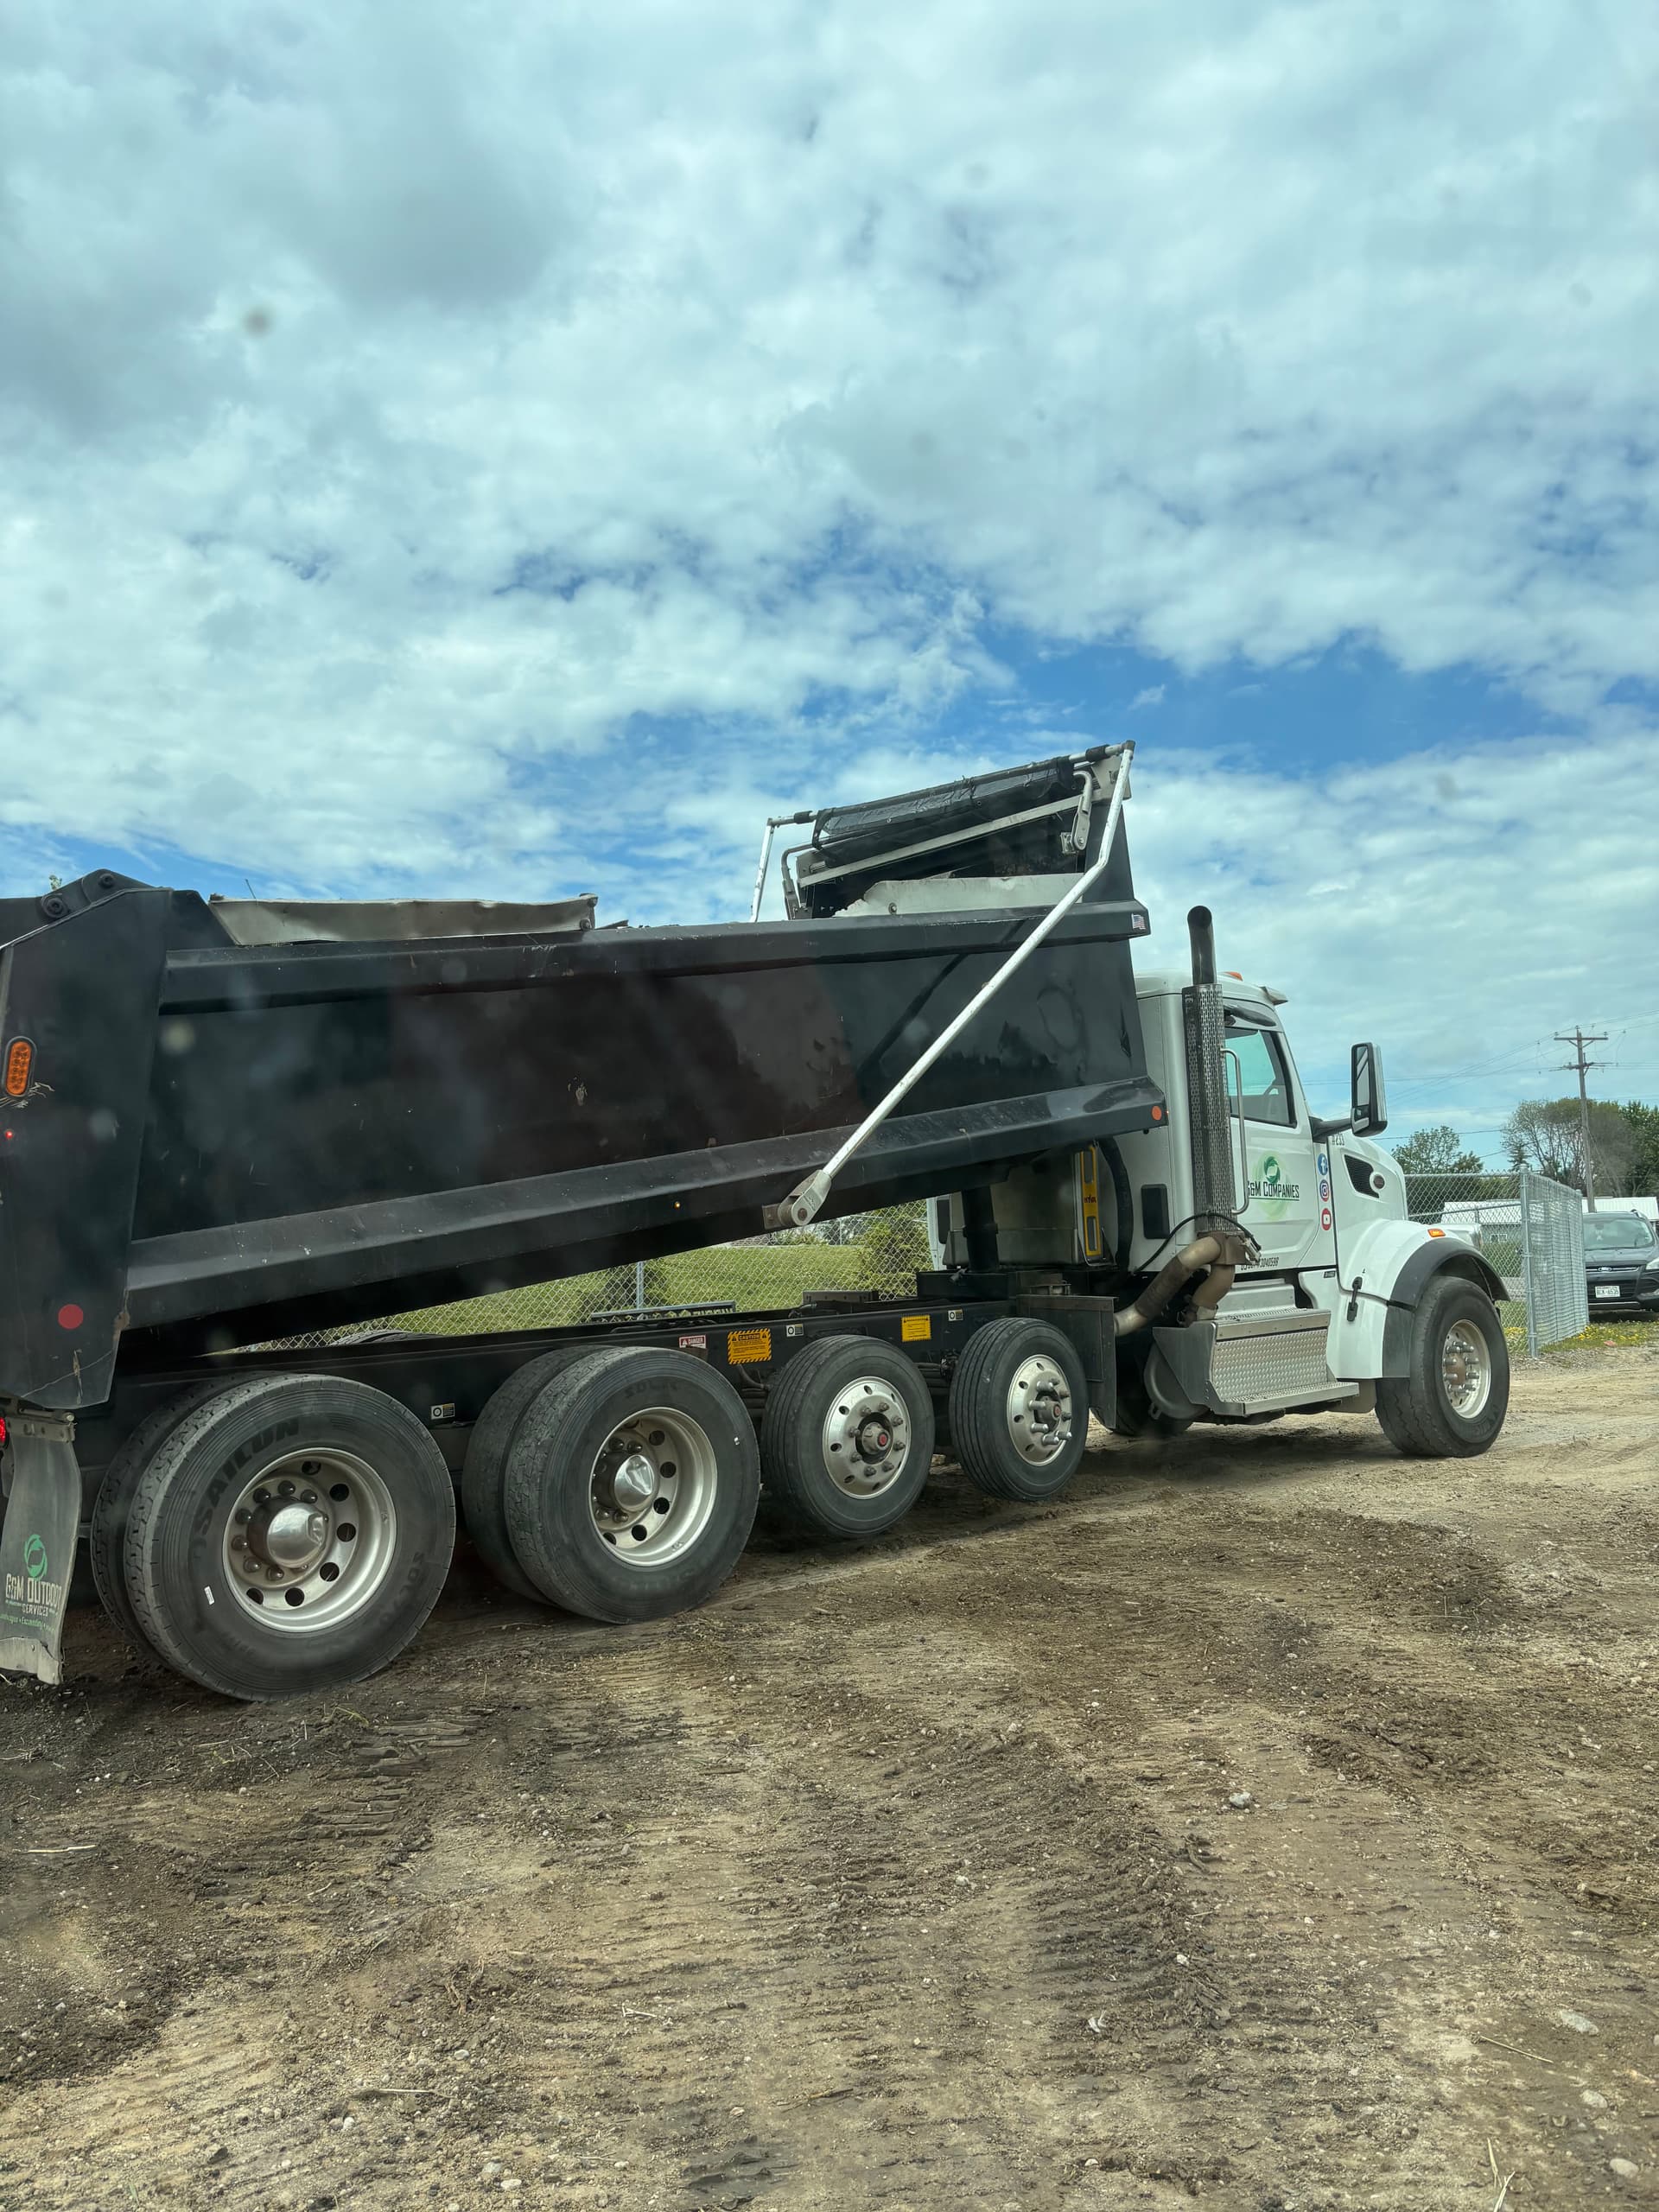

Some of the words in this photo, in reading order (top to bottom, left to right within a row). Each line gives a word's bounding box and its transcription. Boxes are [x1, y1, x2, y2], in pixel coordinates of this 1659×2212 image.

[1263, 1181, 1300, 1198] COMPANIES
[193, 1417, 301, 1535] SAILUN
[5, 1573, 24, 1602] G&M
